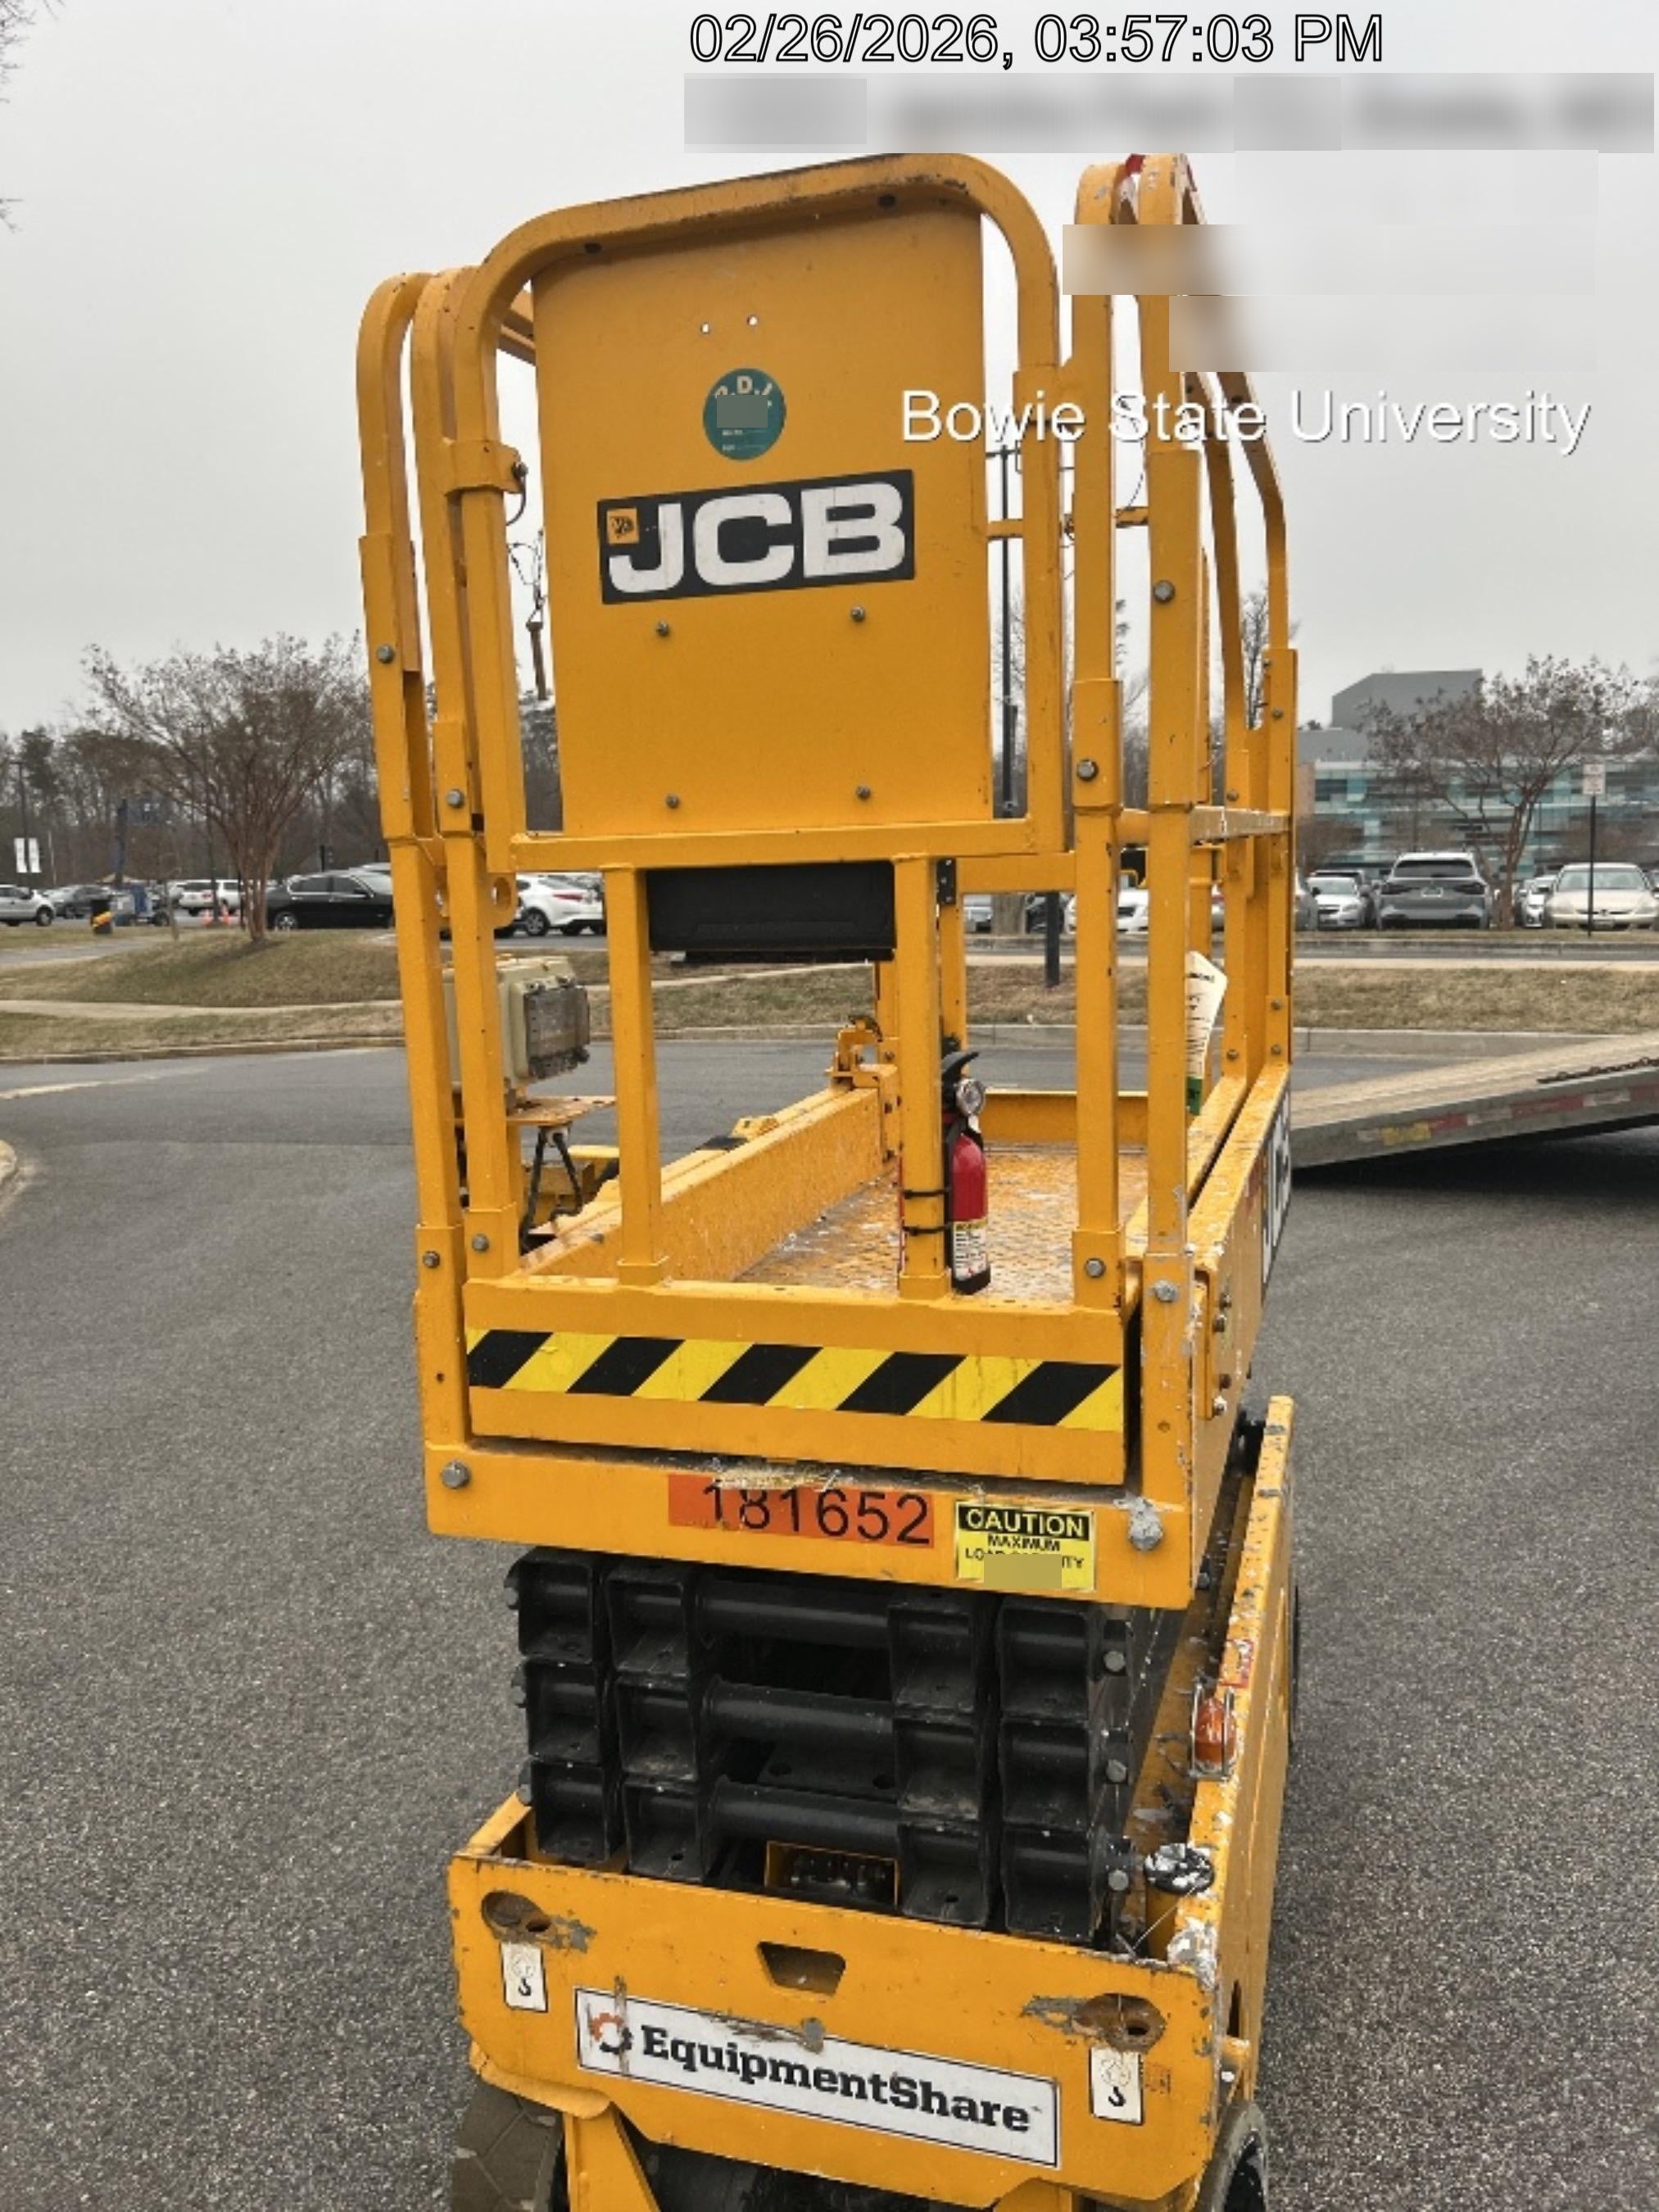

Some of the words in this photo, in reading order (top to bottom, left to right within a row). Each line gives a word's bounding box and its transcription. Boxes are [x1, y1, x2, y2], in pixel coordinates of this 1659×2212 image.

[608, 482, 906, 594] JCB
[703, 1479, 930, 1544] 181652
[966, 1508, 1084, 1538] CAUTION
[987, 1534, 1060, 1552] MAXIMUM
[641, 2024, 1030, 2132] EquipmentShare
